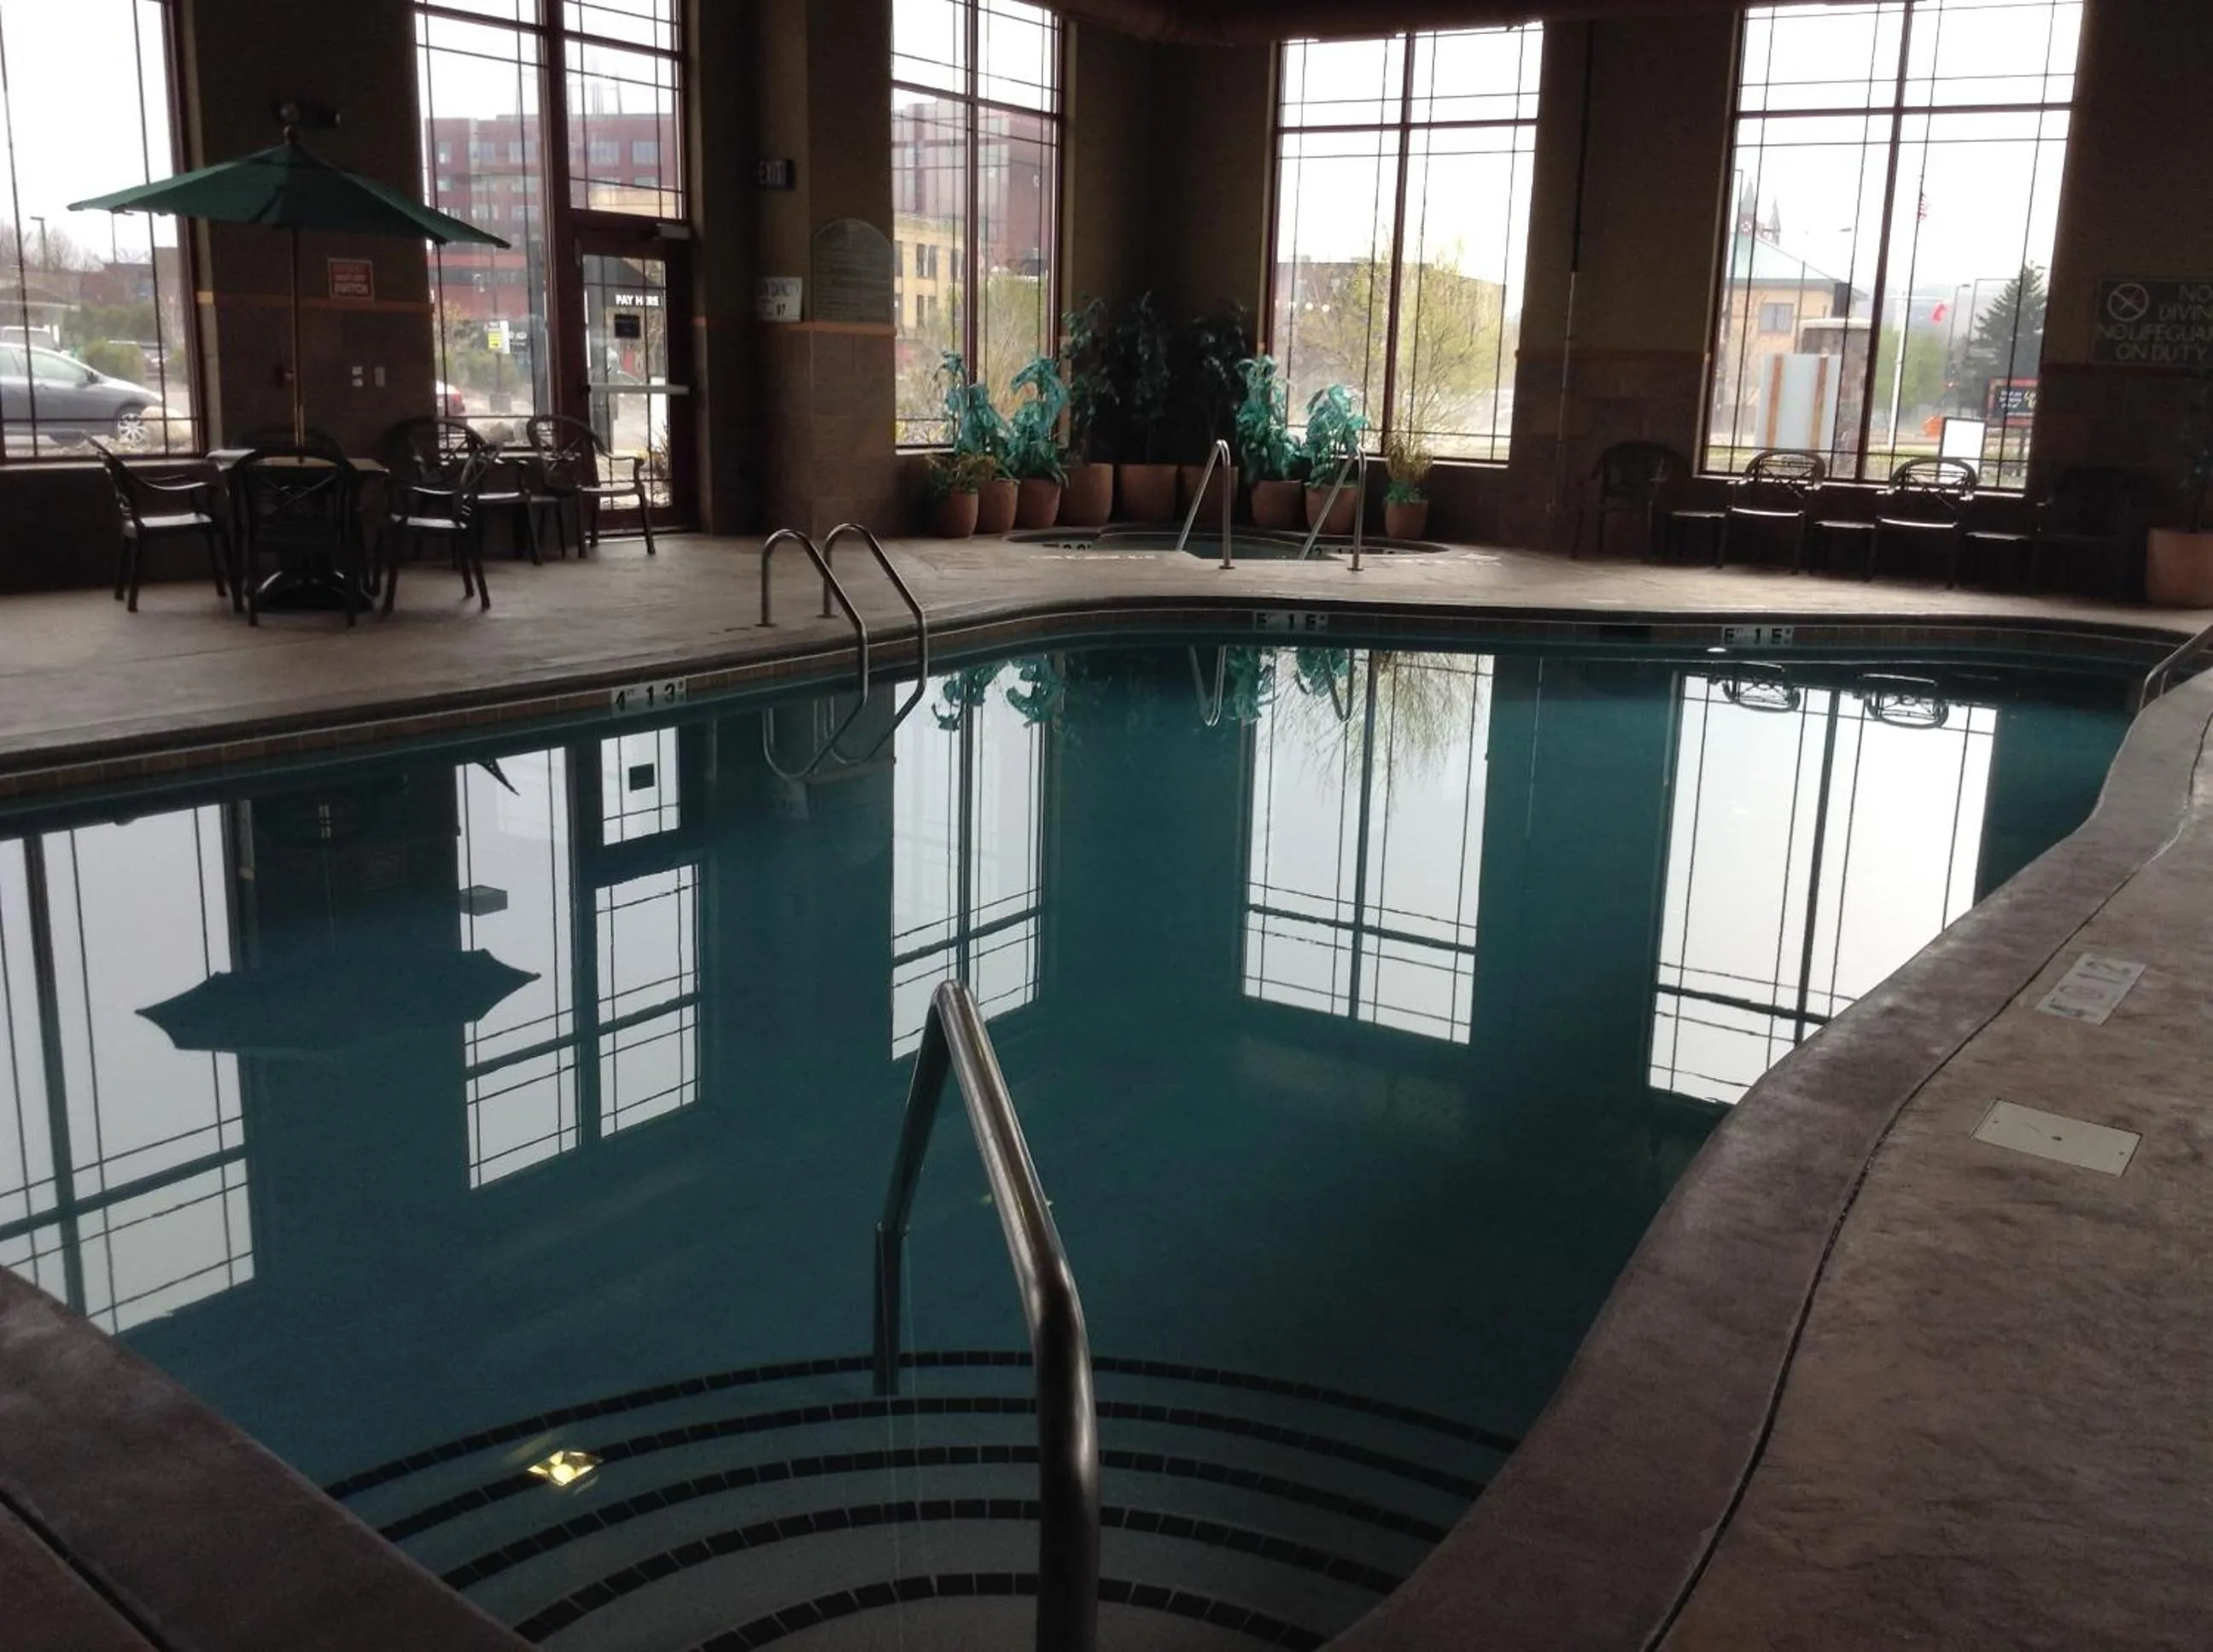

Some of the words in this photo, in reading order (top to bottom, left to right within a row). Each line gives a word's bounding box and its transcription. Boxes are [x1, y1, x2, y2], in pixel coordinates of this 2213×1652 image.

[616, 295, 634, 306] PAY
[2178, 284, 2213, 303] NO
[2098, 323, 2128, 341] NO
[2115, 342, 2146, 359] ON
[2152, 343, 2208, 361] DUTY
